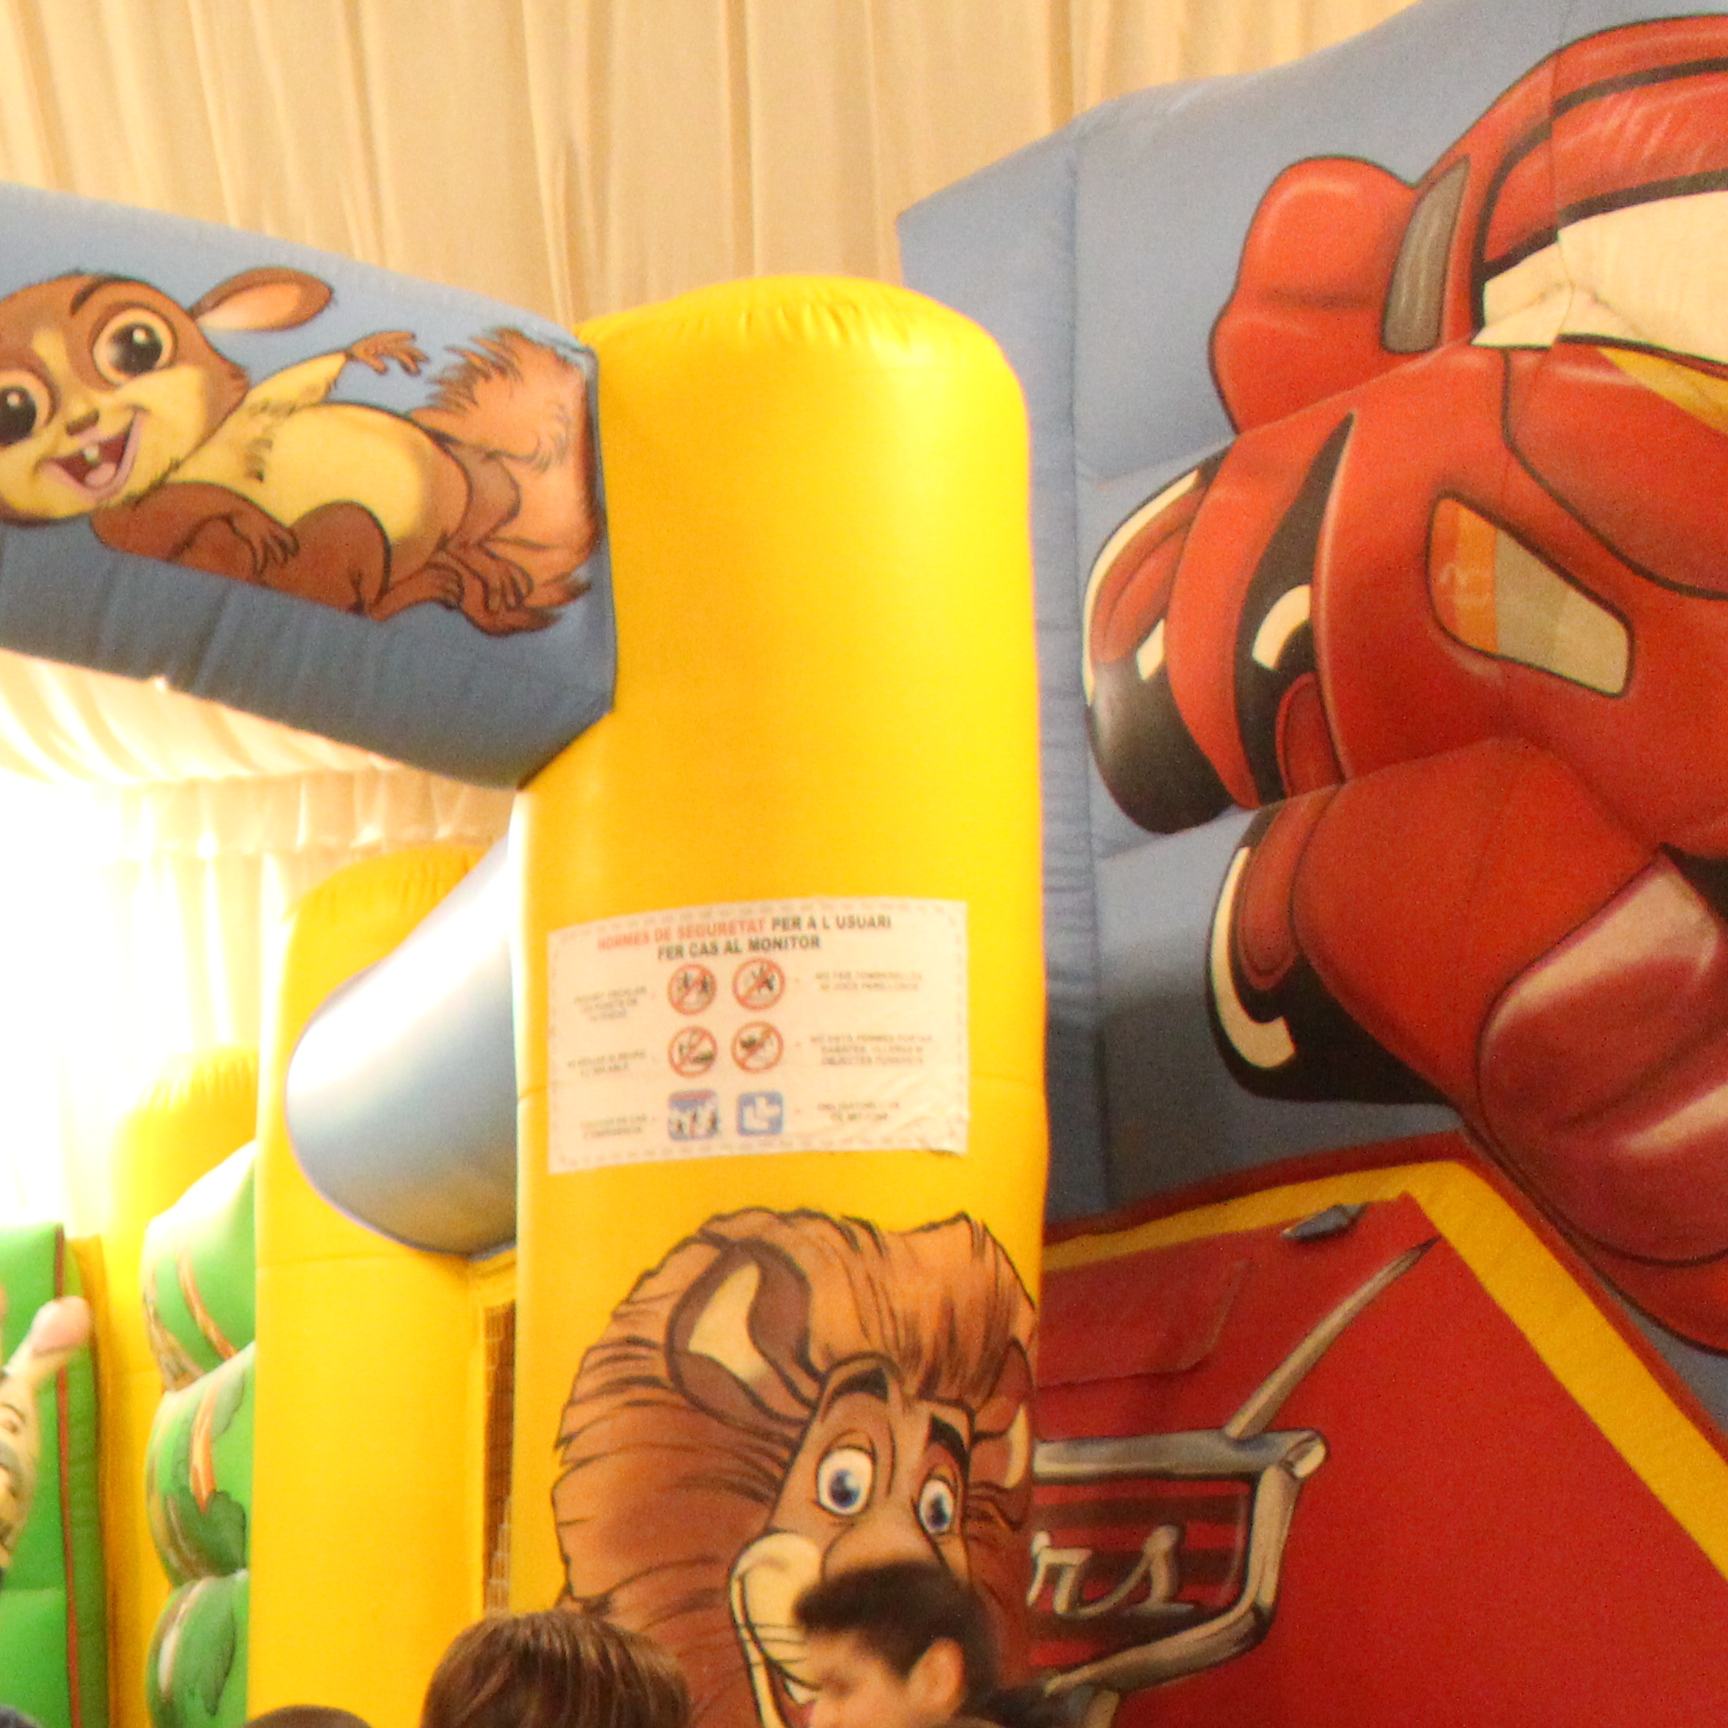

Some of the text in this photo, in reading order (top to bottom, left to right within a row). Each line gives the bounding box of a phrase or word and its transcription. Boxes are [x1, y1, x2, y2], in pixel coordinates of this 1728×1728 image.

[654, 927, 672, 942] DE
[677, 918, 766, 940] SEGURETAT
[771, 915, 802, 932] PER
[806, 915, 818, 930] A
[836, 914, 892, 931] USUARI
[688, 940, 720, 957] CAS
[723, 937, 744, 954] AL
[748, 934, 821, 952] MONITOR
